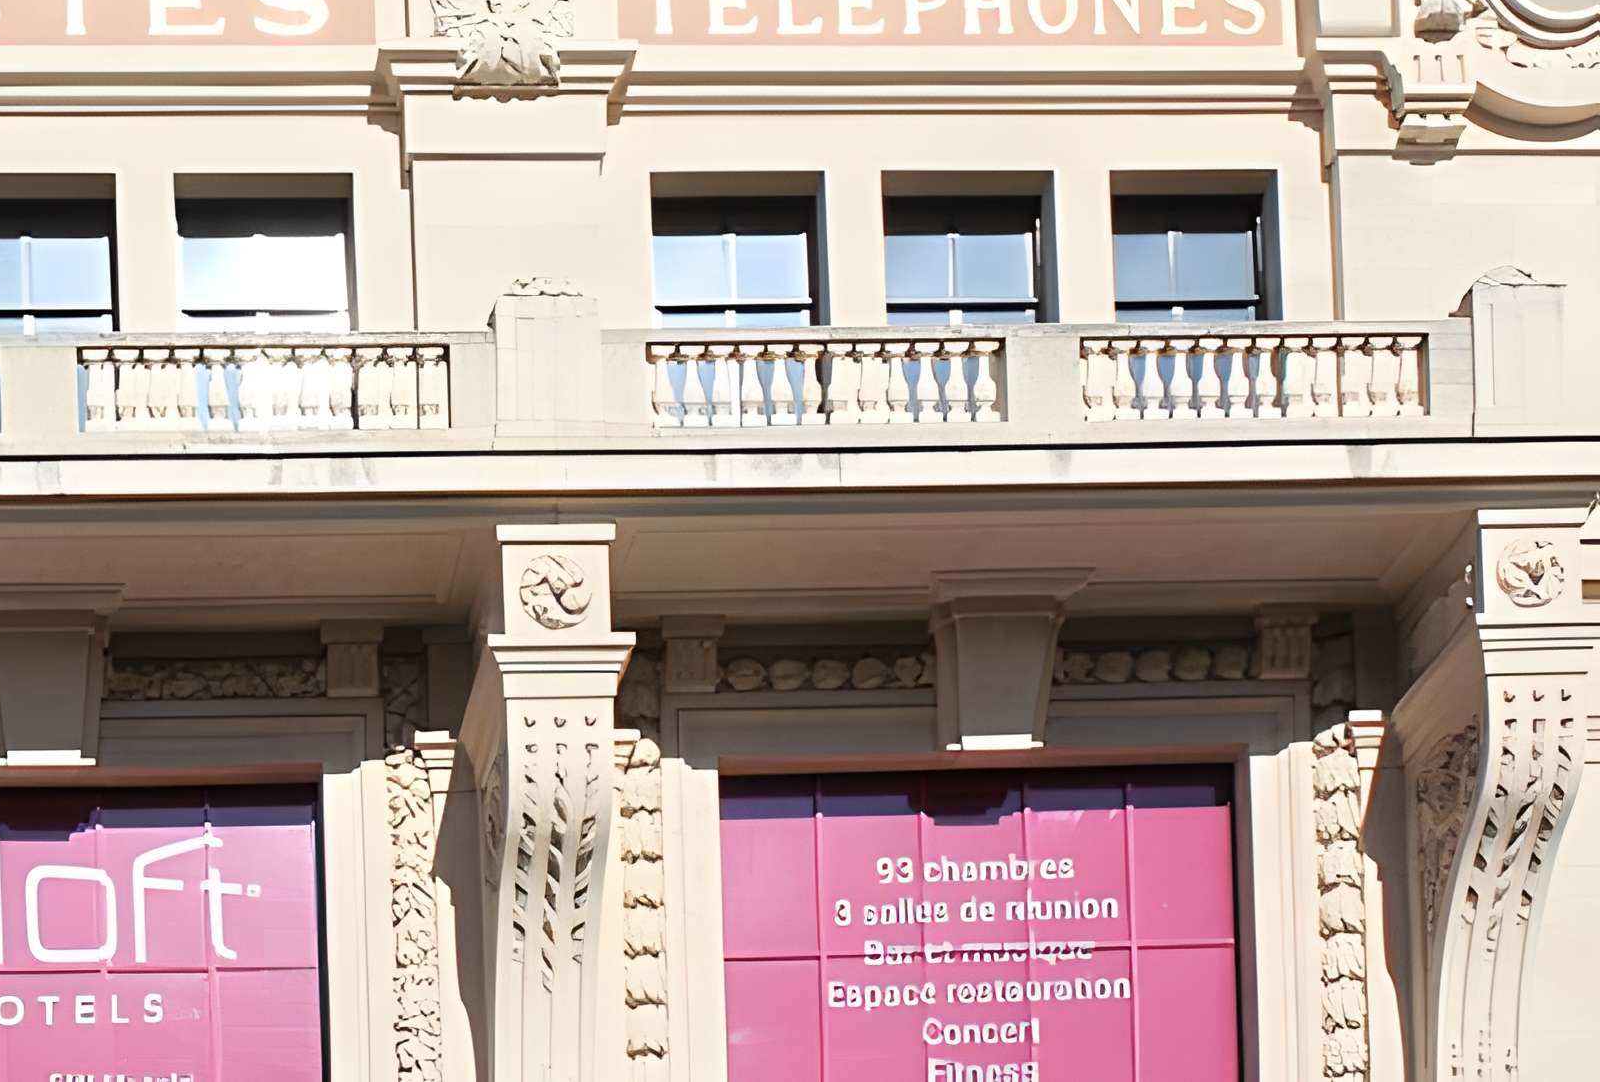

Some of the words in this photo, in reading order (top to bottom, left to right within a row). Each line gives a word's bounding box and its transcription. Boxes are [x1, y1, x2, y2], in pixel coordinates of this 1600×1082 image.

[923, 854, 1075, 882] chambres
[863, 897, 949, 926] salles
[959, 895, 996, 923] de
[1005, 886, 1119, 921] réunion
[827, 981, 936, 1011] Espace
[947, 976, 1131, 1004] restauration
[922, 1018, 1040, 1045] Concert
